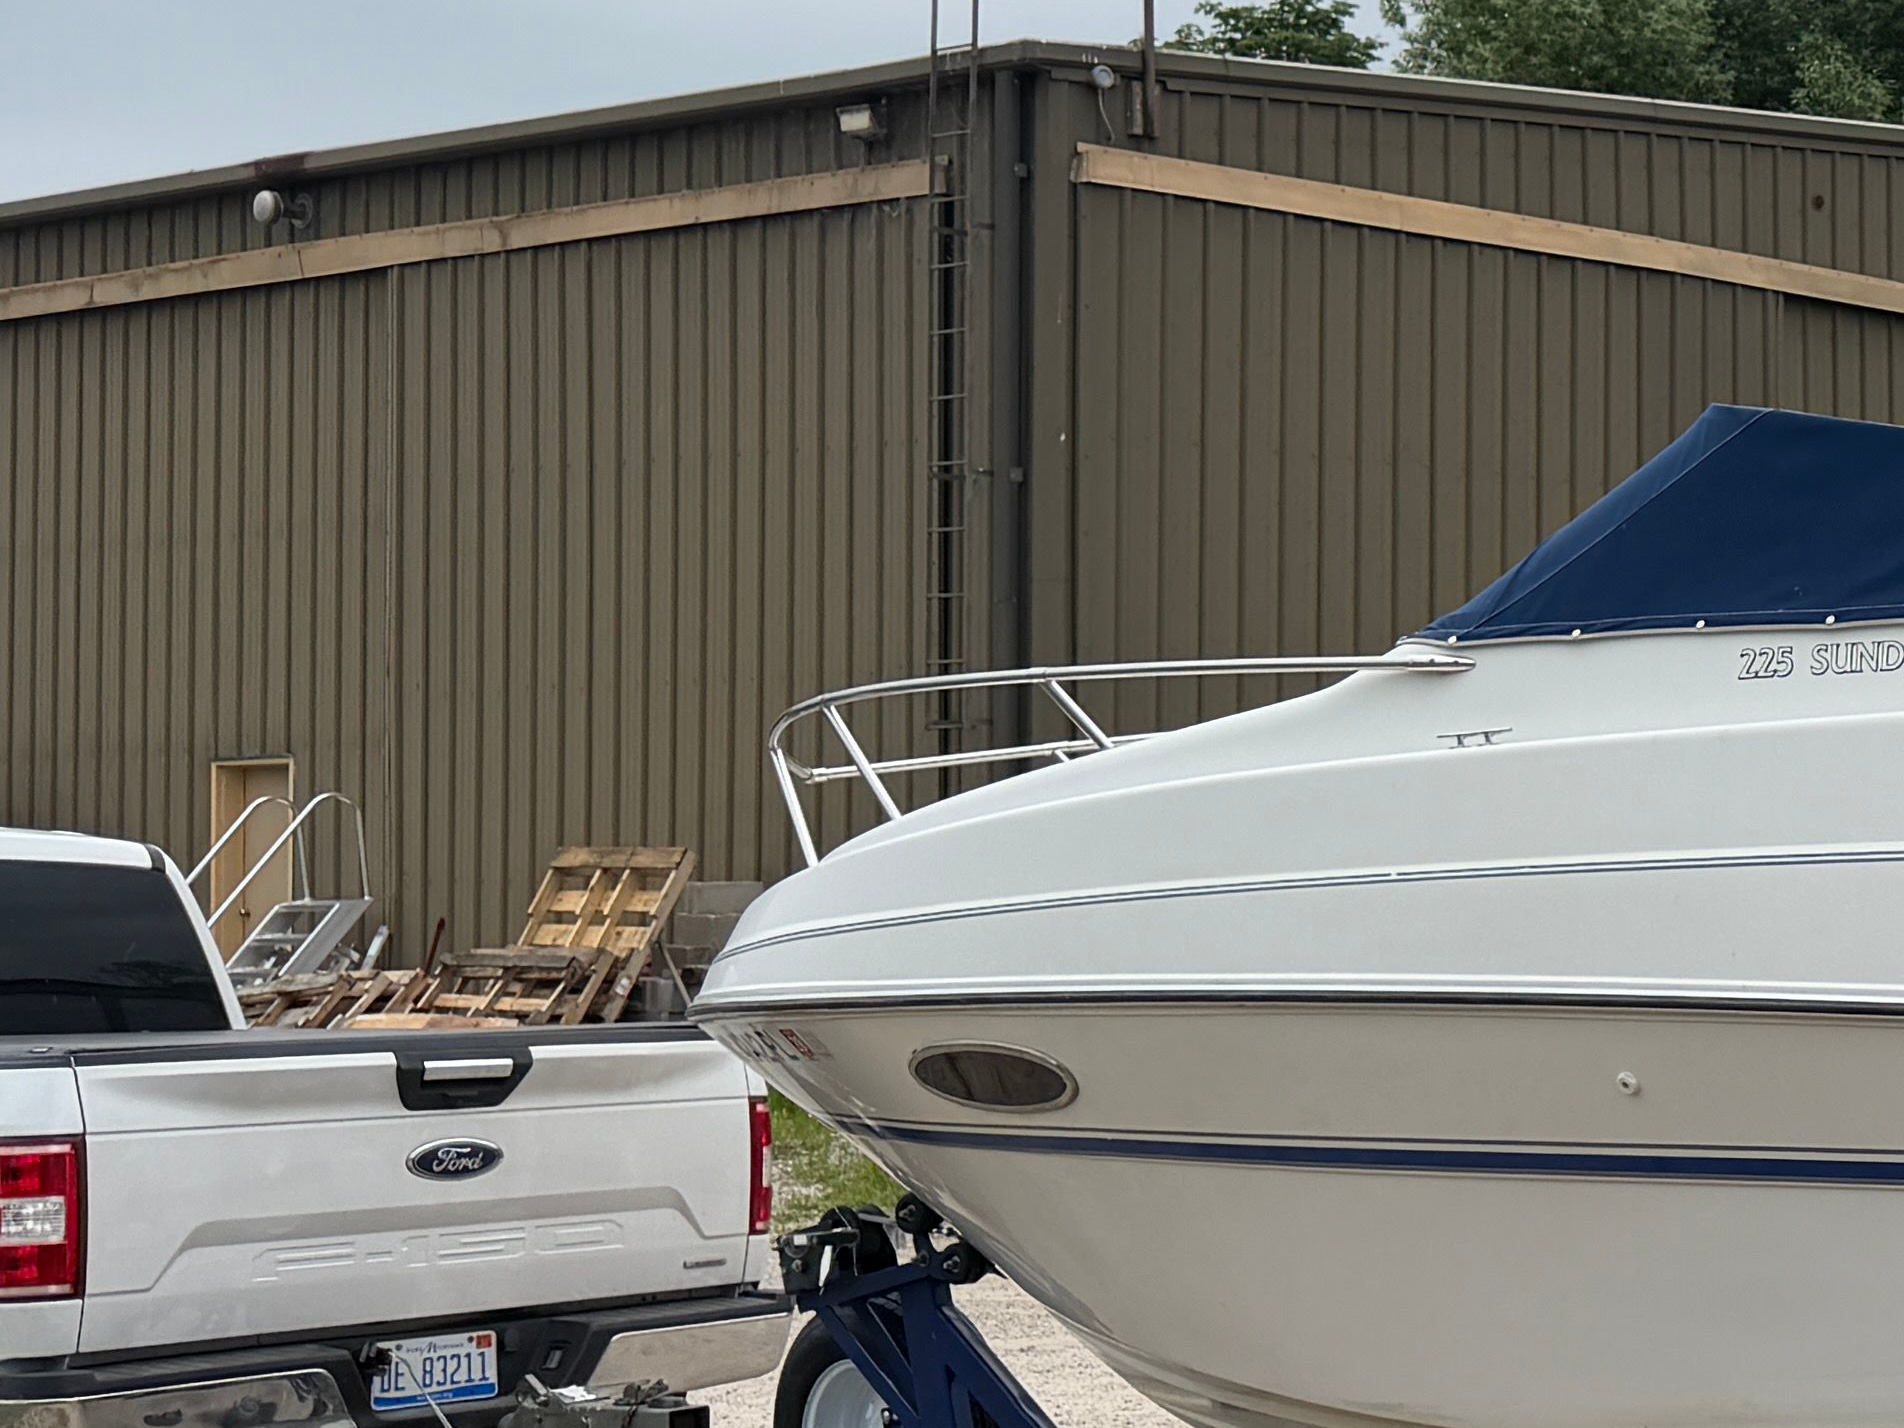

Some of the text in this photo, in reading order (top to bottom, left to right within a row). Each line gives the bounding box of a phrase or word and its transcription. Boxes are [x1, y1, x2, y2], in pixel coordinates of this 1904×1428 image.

[1738, 646, 1794, 680] 225
[432, 1147, 484, 1173] Ford
[251, 1220, 625, 1281] F-150
[422, 1350, 490, 1389] 83211
